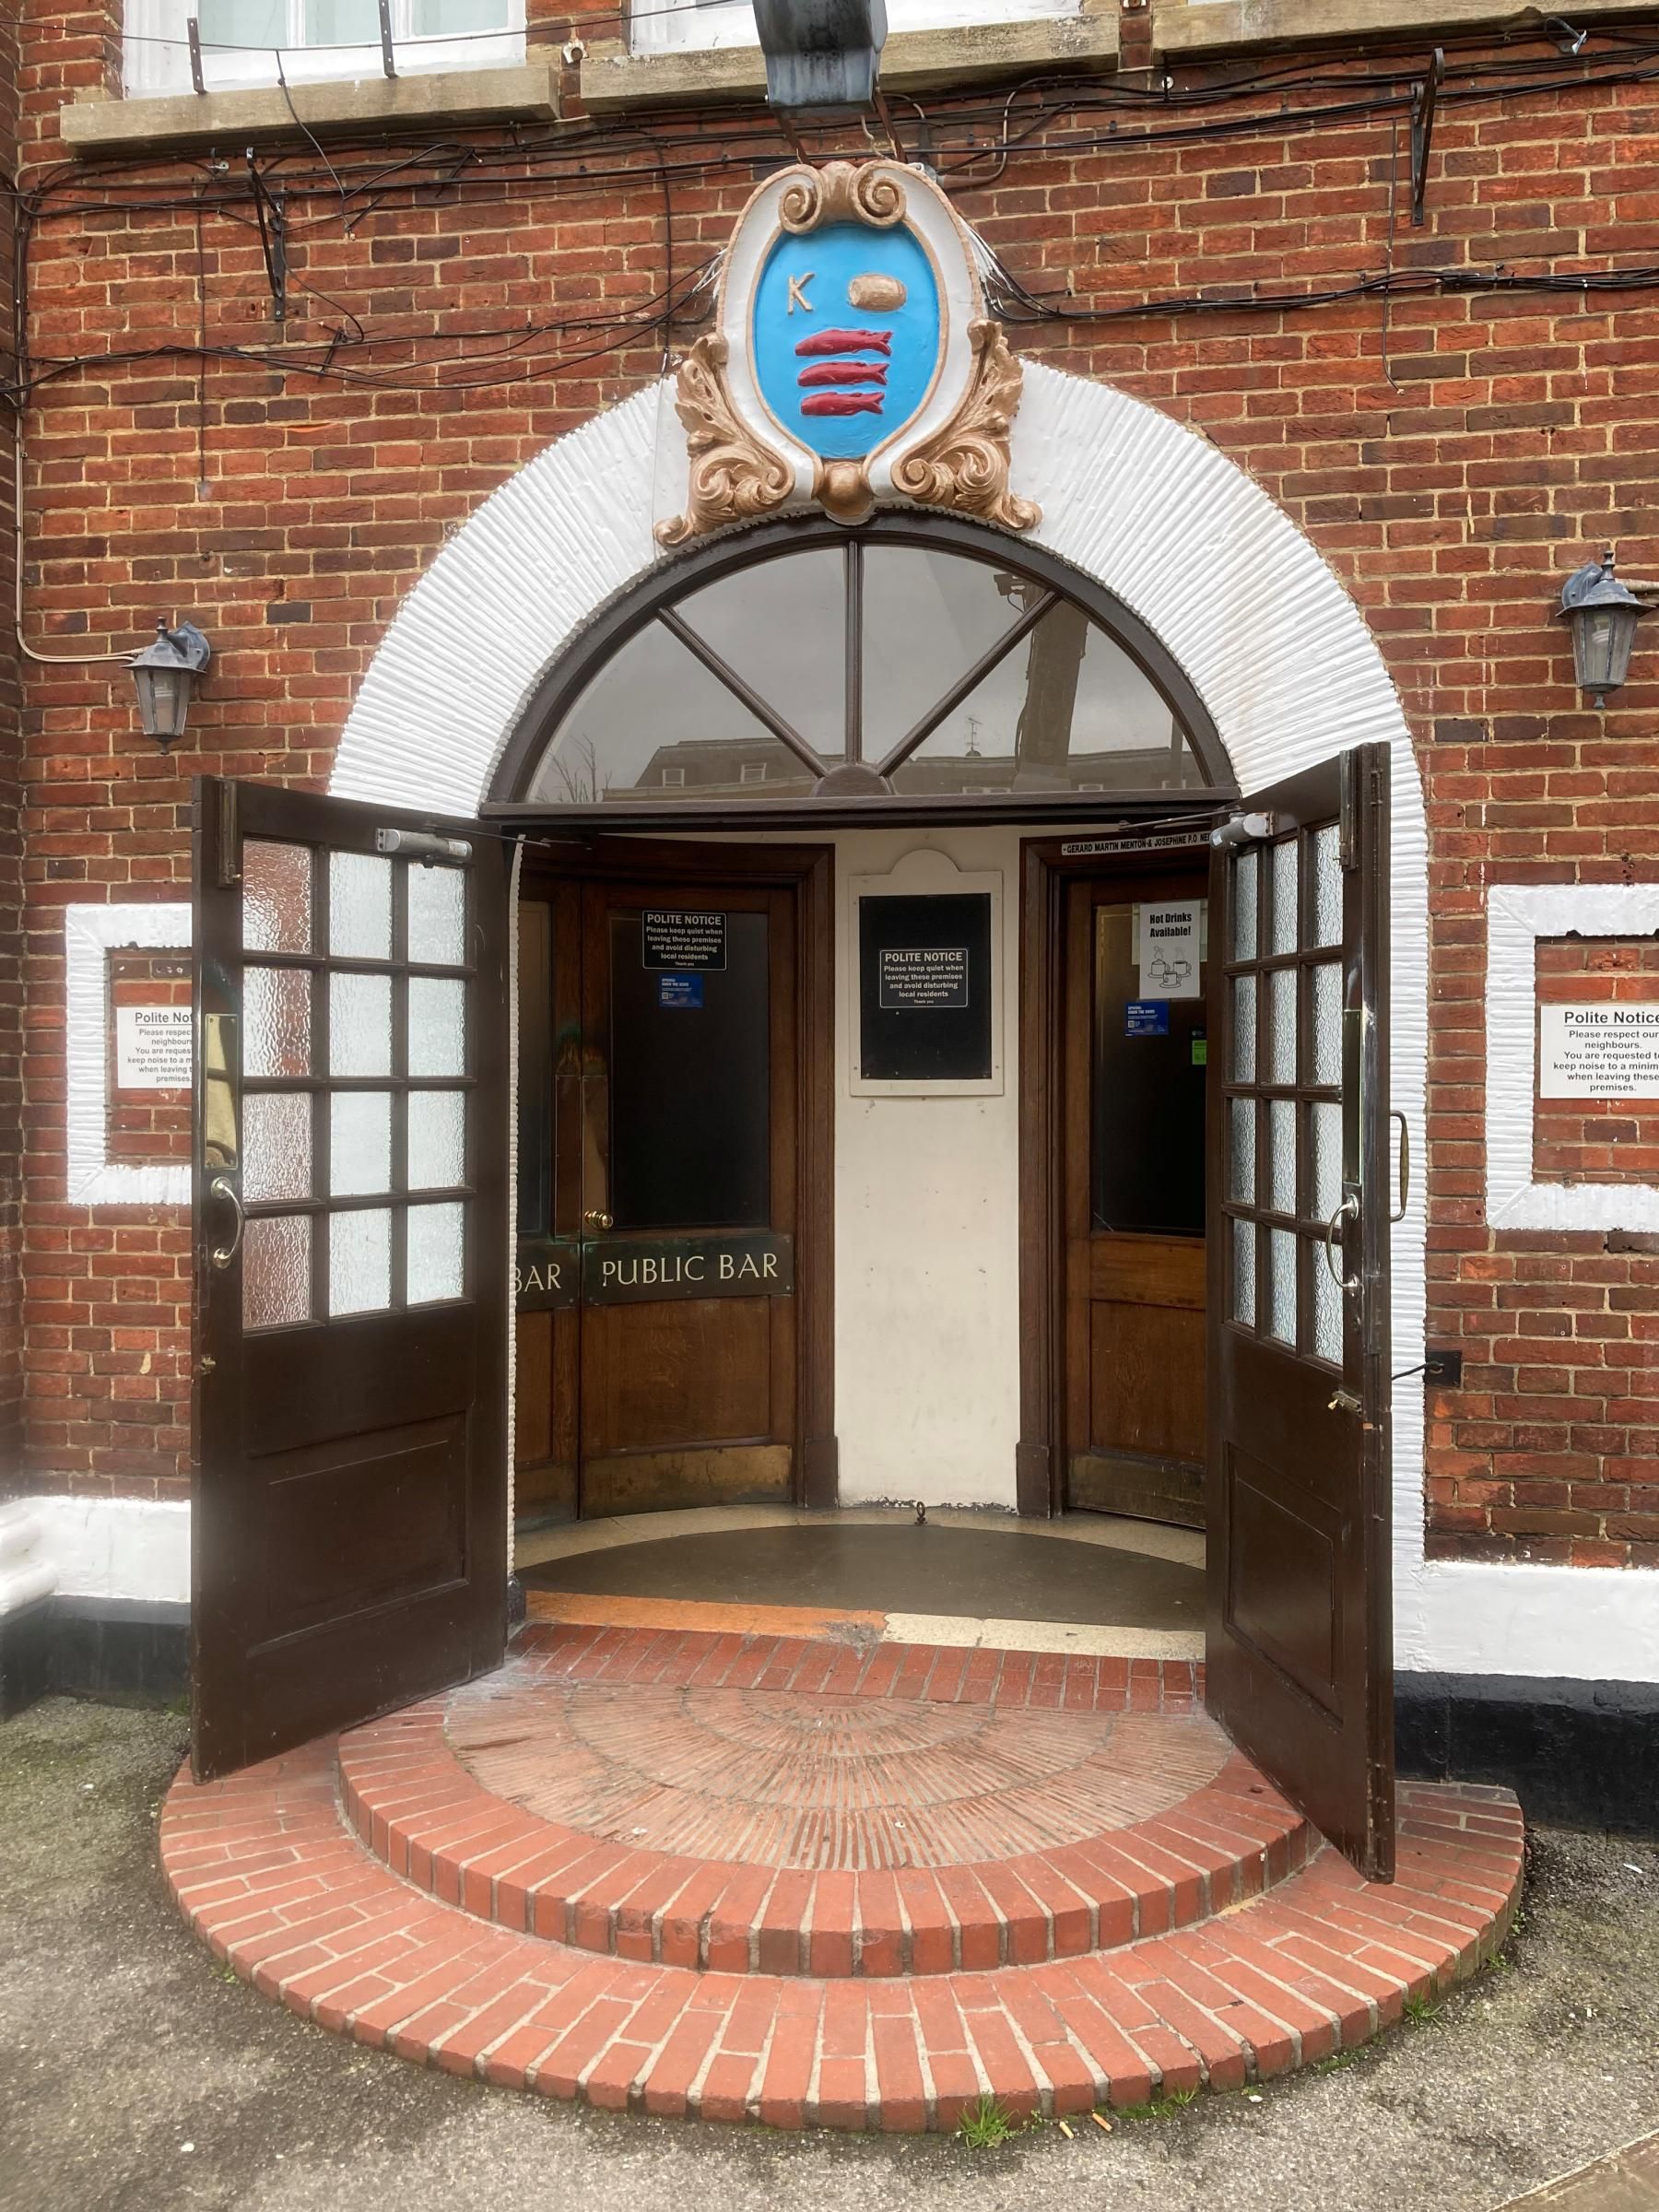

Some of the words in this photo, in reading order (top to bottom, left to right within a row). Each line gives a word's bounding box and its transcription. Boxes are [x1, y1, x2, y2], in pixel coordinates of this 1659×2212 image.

[787, 272, 816, 315] K
[1066, 843, 1093, 853] GERARD
[1094, 841, 1119, 852] MARTIN
[1120, 840, 1146, 850] MENTON
[1154, 835, 1187, 847] JOSEPHINE
[647, 913, 682, 924] POLITE
[685, 915, 722, 925] NOTICE
[1149, 913, 1164, 924] Hot
[1165, 912, 1192, 923] Drinks
[1149, 925, 1191, 937] Available!
[647, 935, 671, 943] leaving
[684, 945, 717, 953] disturbing
[885, 952, 922, 962] POLITE
[924, 952, 963, 961] NOTICE
[135, 1012, 169, 1023] Polite
[1564, 1011, 1608, 1023] Polite
[1569, 1030, 1601, 1038] Please
[1604, 1030, 1640, 1040] respect
[1585, 1041, 1642, 1050] neighbours.
[127, 1056, 146, 1065] keep
[1603, 1052, 1651, 1061] requested
[160, 1065, 187, 1074] leaving
[1553, 1062, 1576, 1071] keep
[1595, 1073, 1630, 1082] leaving
[1590, 1083, 1637, 1092] premises.
[602, 1255, 705, 1287] PUBLIC
[719, 1253, 779, 1280] BAR
